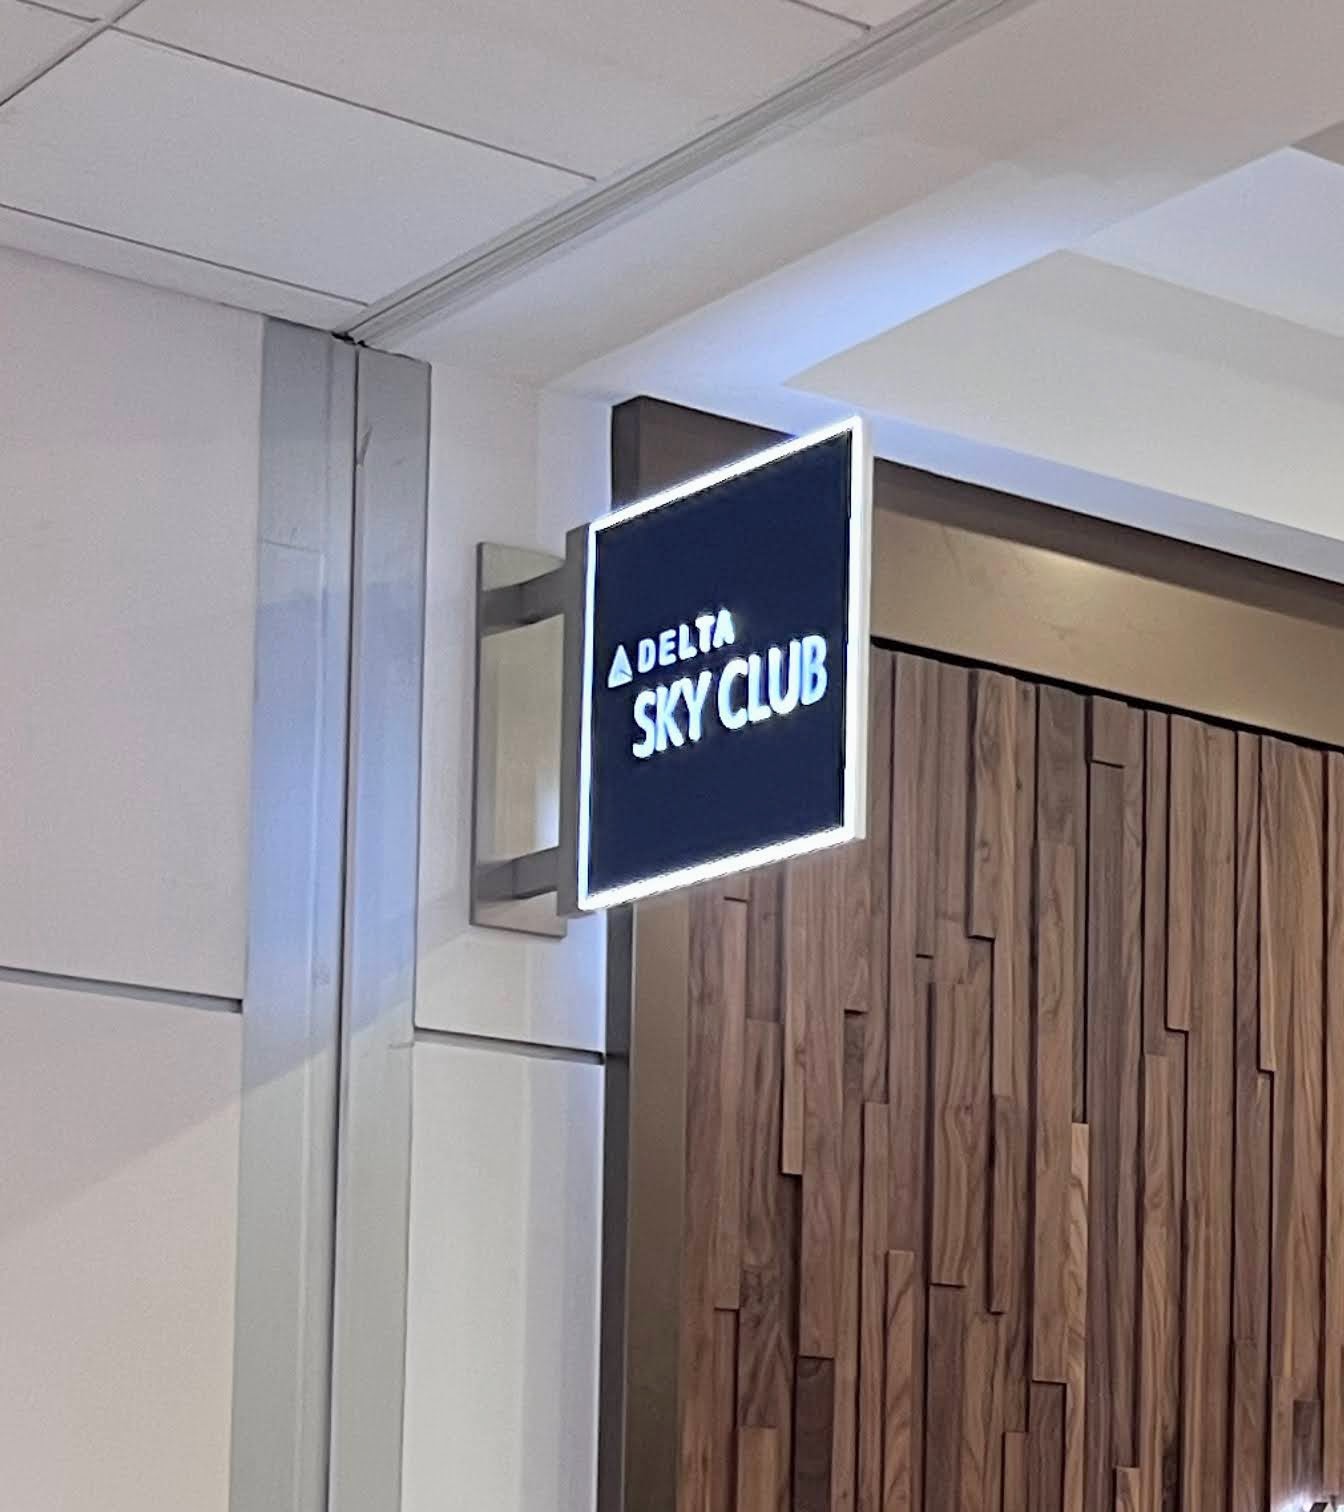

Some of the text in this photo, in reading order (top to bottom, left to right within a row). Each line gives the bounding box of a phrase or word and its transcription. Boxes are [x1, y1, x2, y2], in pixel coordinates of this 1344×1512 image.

[637, 609, 735, 673] DELTA
[632, 634, 828, 758] SKY CLUB
